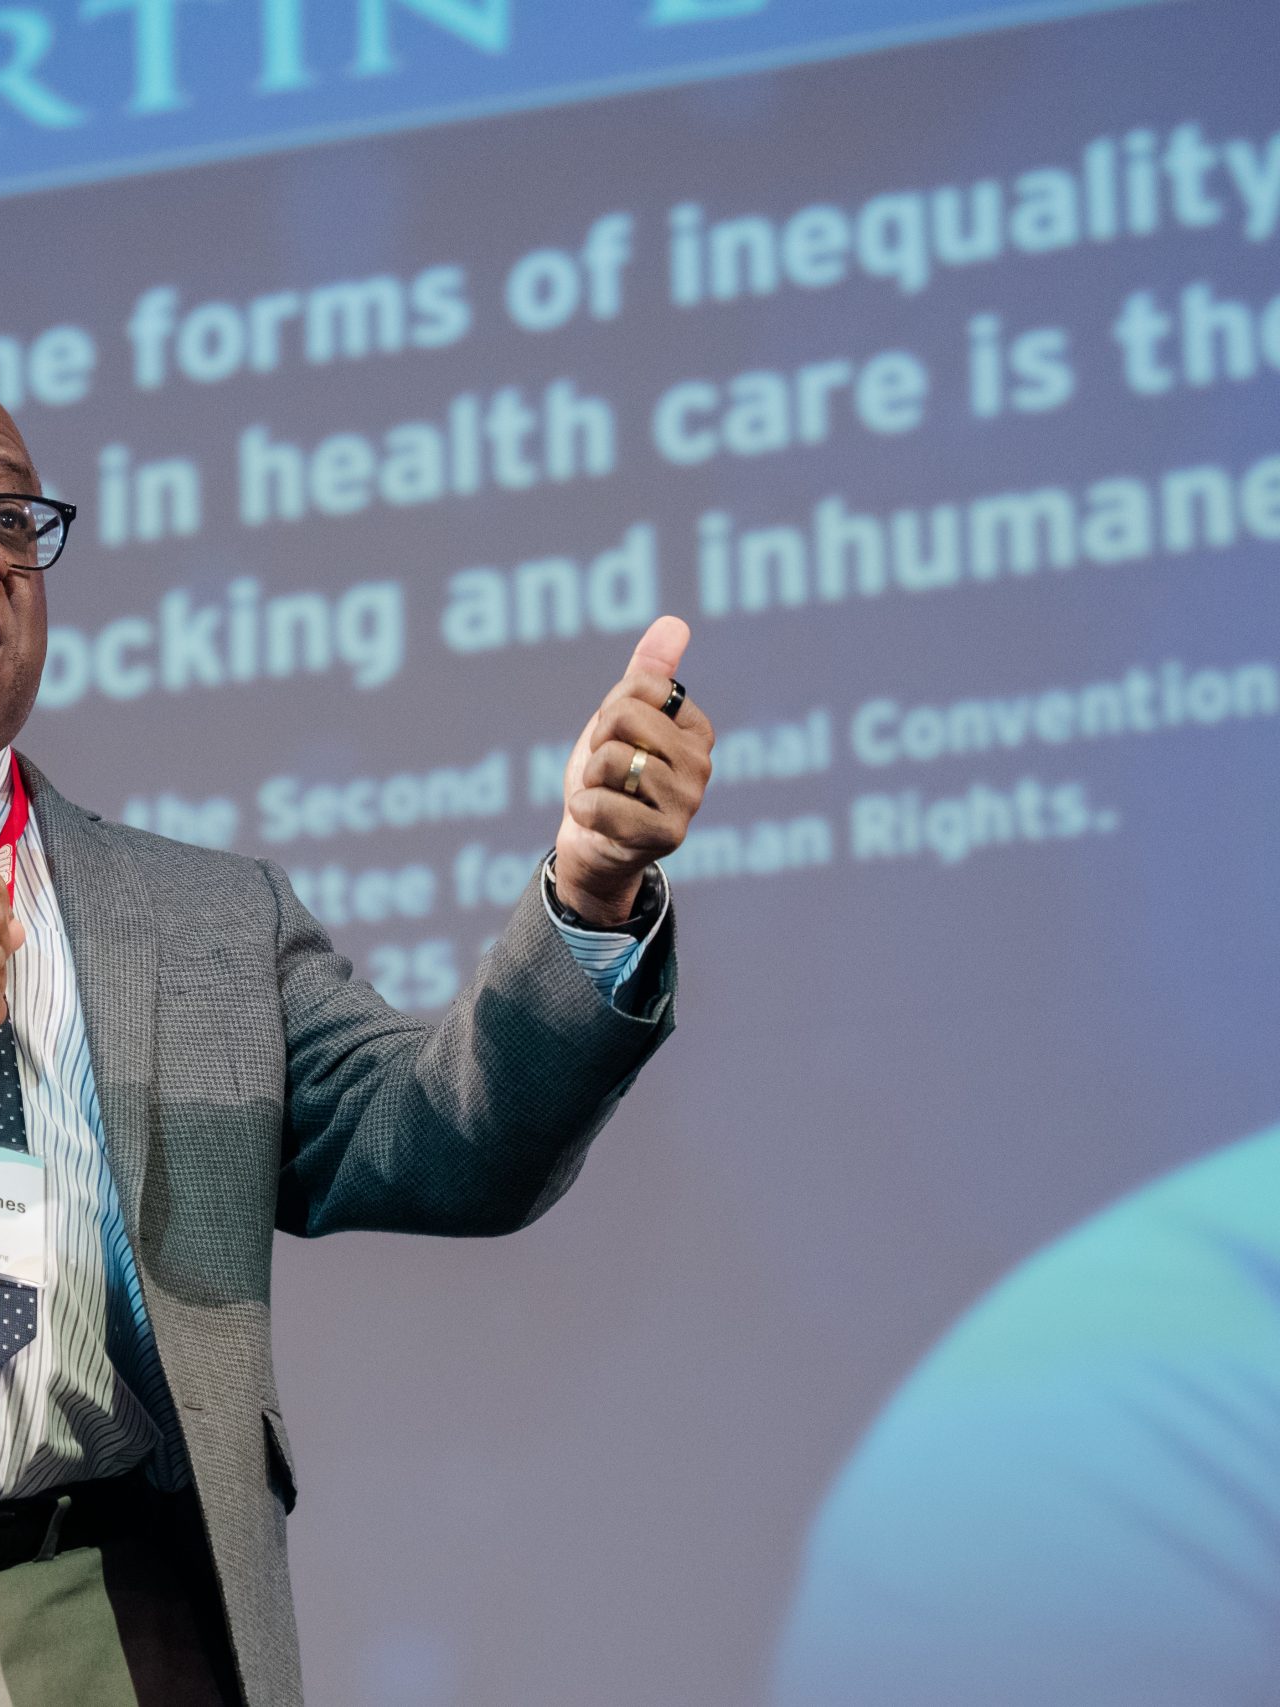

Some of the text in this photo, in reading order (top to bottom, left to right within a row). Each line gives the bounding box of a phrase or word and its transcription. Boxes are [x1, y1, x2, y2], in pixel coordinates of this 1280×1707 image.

[129, 266, 473, 393] forms
[506, 213, 632, 331] of
[670, 125, 1280, 294] inequality
[99, 443, 201, 547] in
[239, 379, 617, 525] health
[652, 350, 929, 464] care
[969, 313, 1075, 418] is
[36, 575, 406, 708] ocking
[441, 522, 659, 653] and
[698, 454, 1280, 615] inhumane
[257, 752, 510, 842] Second
[851, 660, 1280, 767] Convention
[851, 777, 1118, 864] Rights.
